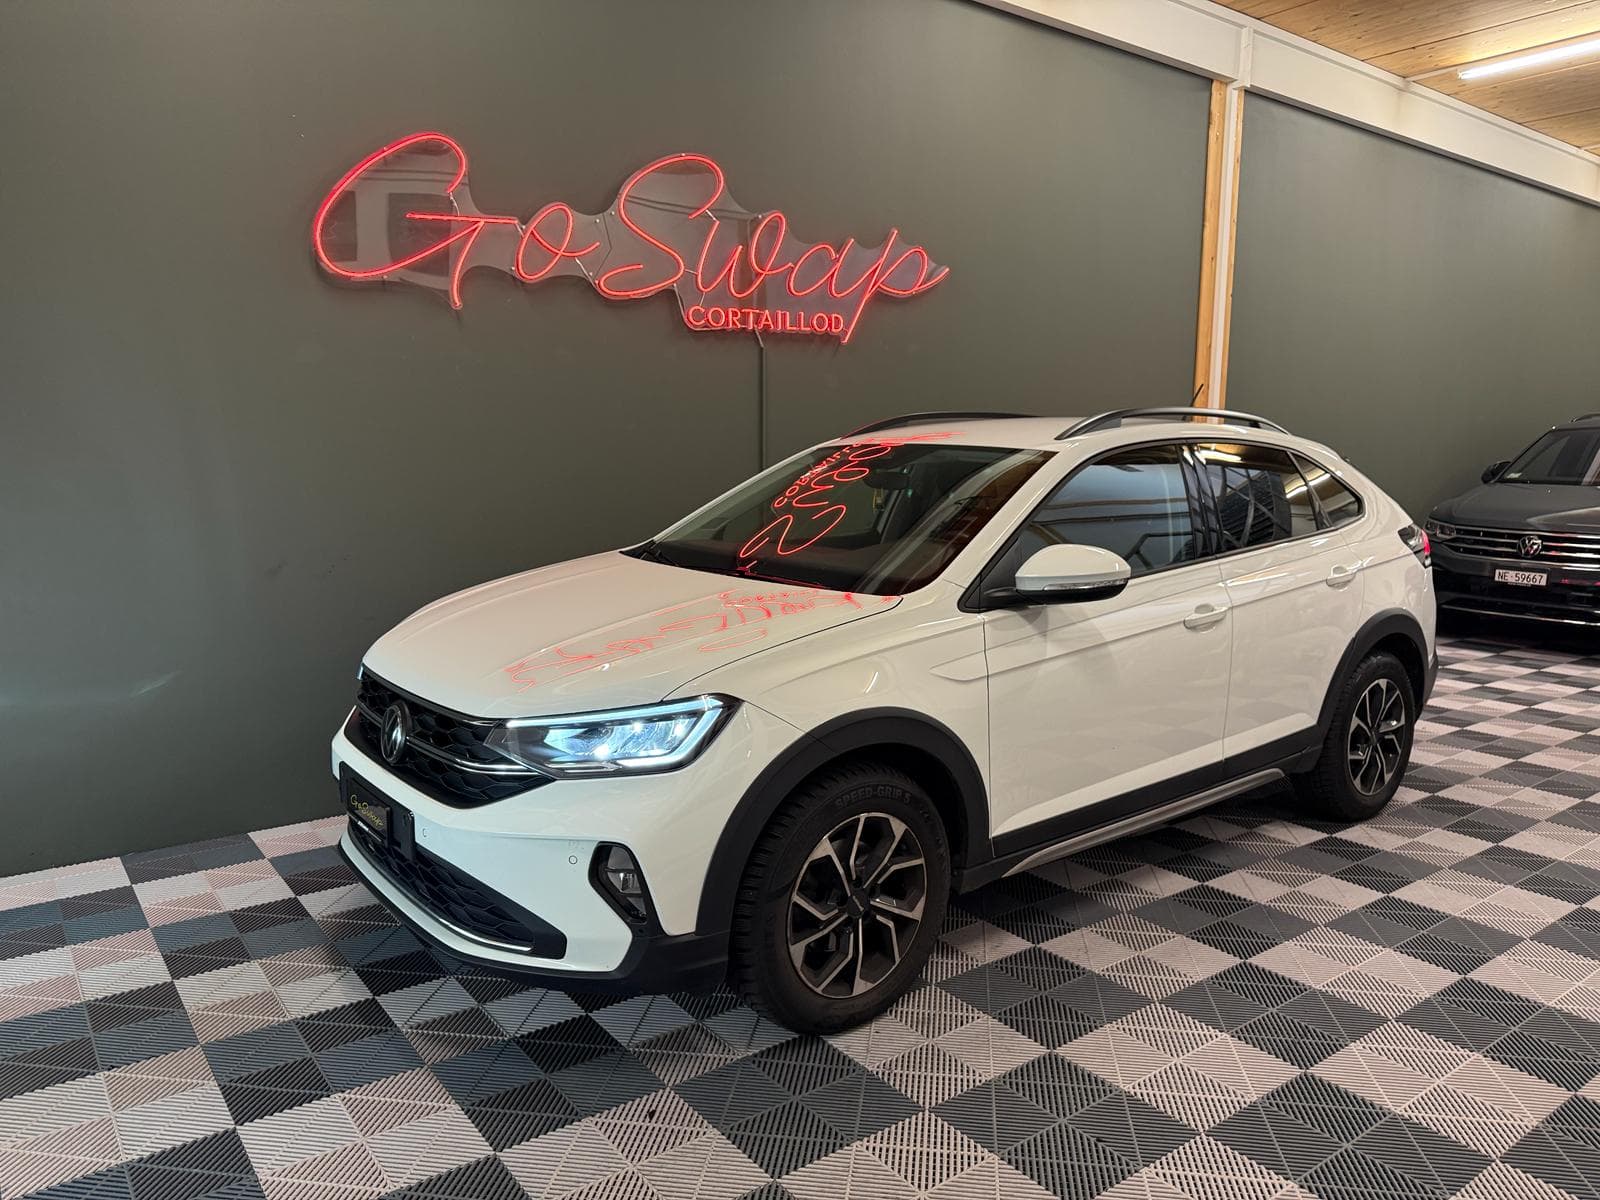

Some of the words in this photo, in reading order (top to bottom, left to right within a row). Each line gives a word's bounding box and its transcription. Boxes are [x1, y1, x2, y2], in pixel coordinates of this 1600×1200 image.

[687, 305, 845, 333] CORTAILLOD
[1498, 571, 1509, 581] NE
[1515, 573, 1543, 584] 59667
